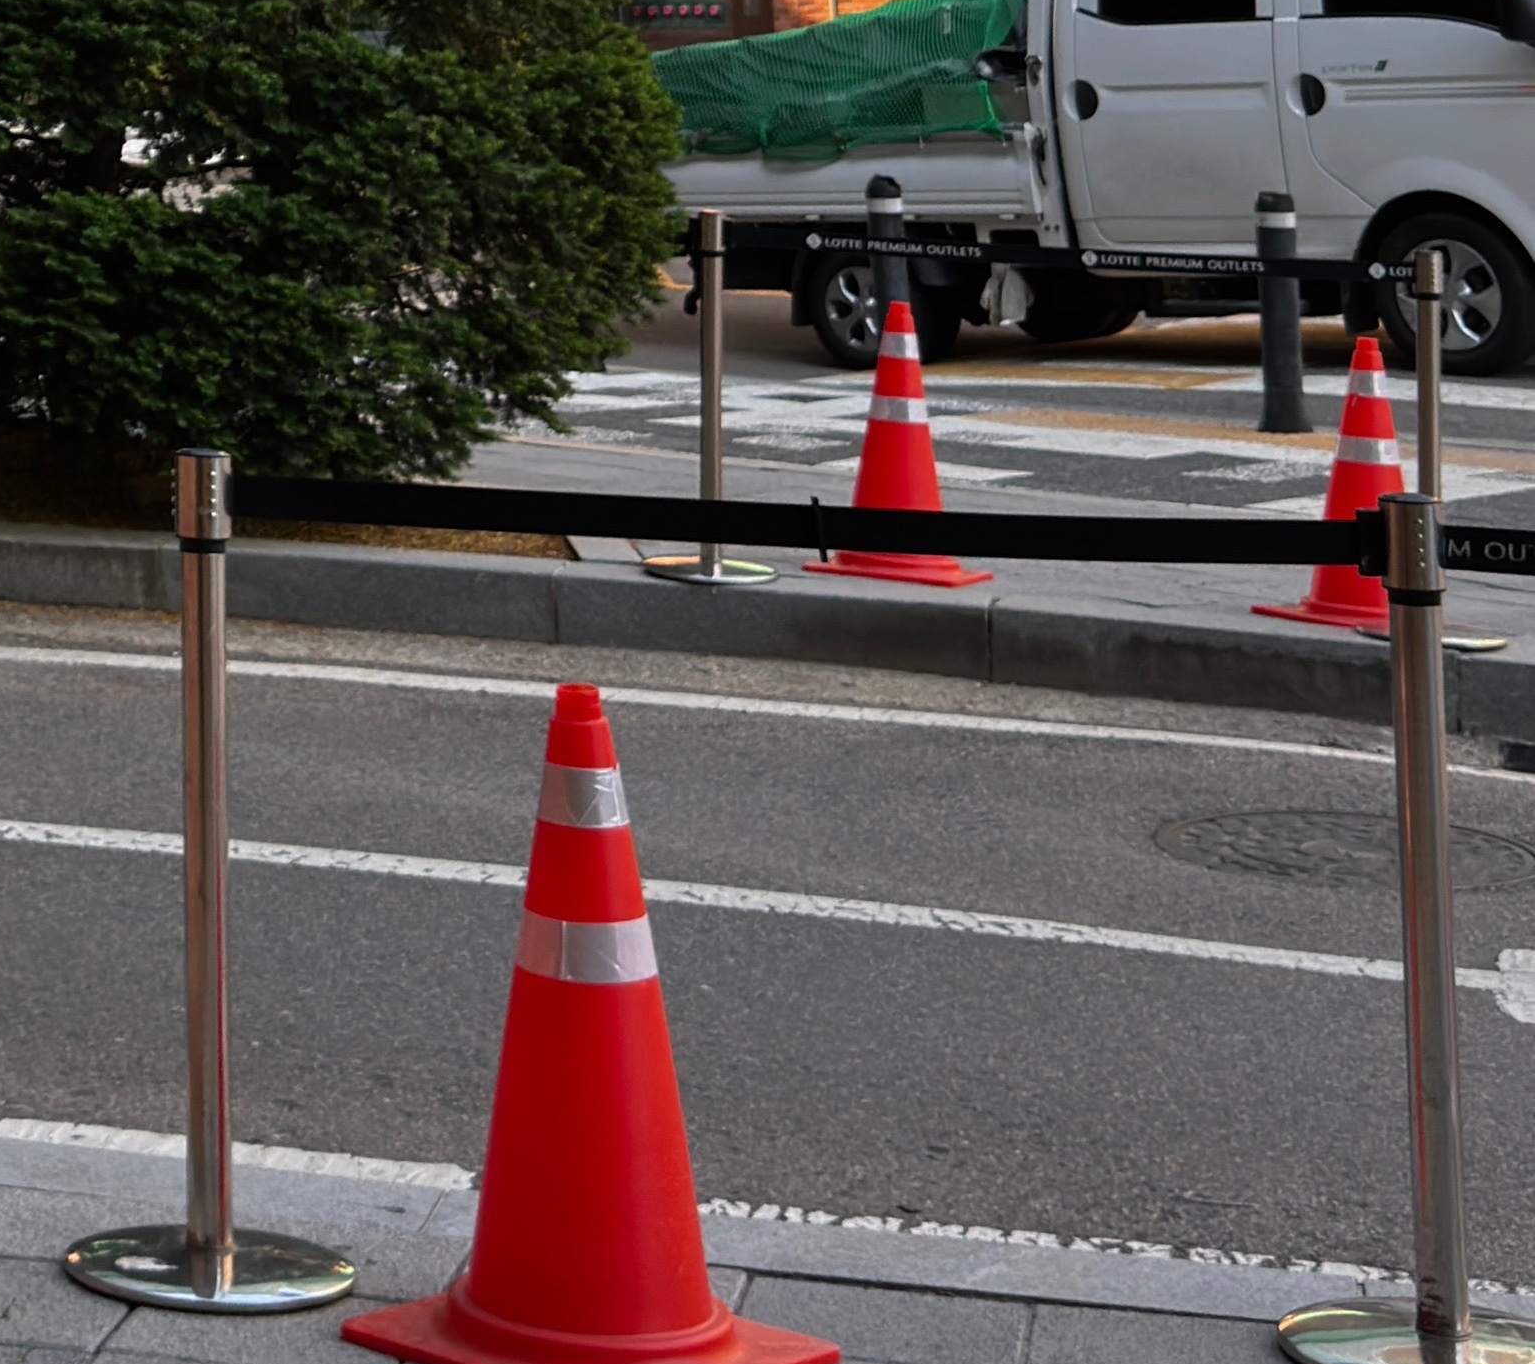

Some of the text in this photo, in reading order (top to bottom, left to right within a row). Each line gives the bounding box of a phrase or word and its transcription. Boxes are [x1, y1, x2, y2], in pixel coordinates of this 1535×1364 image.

[824, 237, 982, 257] LOTTE PREMIUM OUTLETS
[1100, 255, 1265, 272] LOTTE PREMIUM OUTLETS
[1484, 541, 1535, 562] OU
